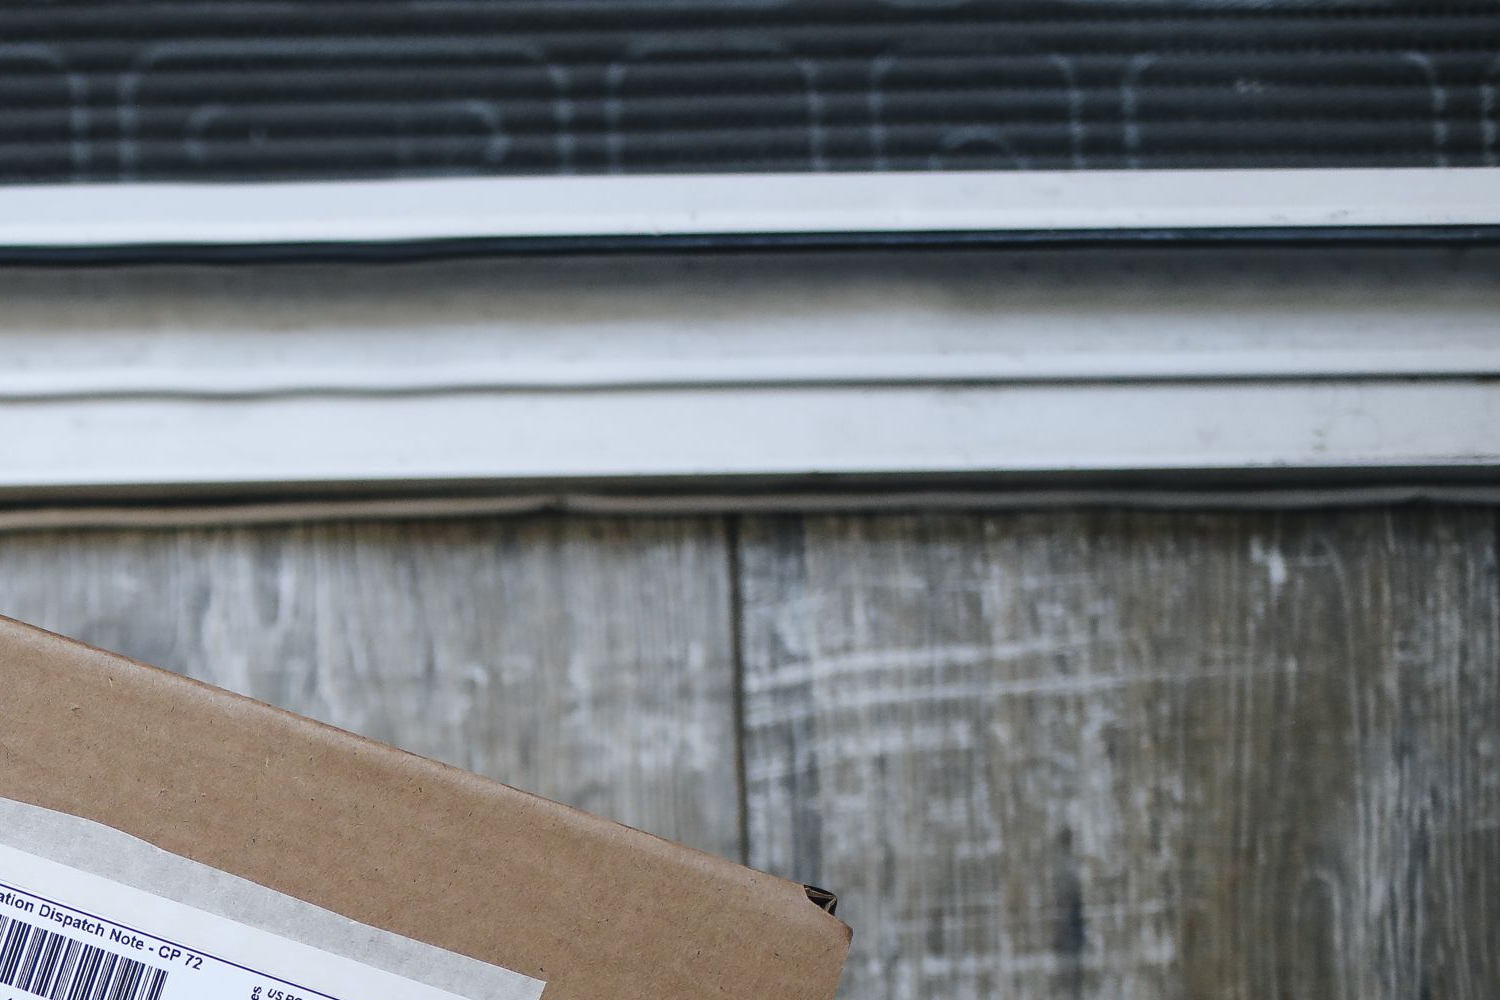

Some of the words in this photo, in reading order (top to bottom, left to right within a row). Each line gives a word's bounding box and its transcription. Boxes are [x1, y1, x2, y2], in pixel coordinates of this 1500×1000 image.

[38, 903, 105, 938] Dispatch
[108, 927, 145, 951] Note
[158, 944, 182, 961] CP
[184, 952, 204, 971] 72
